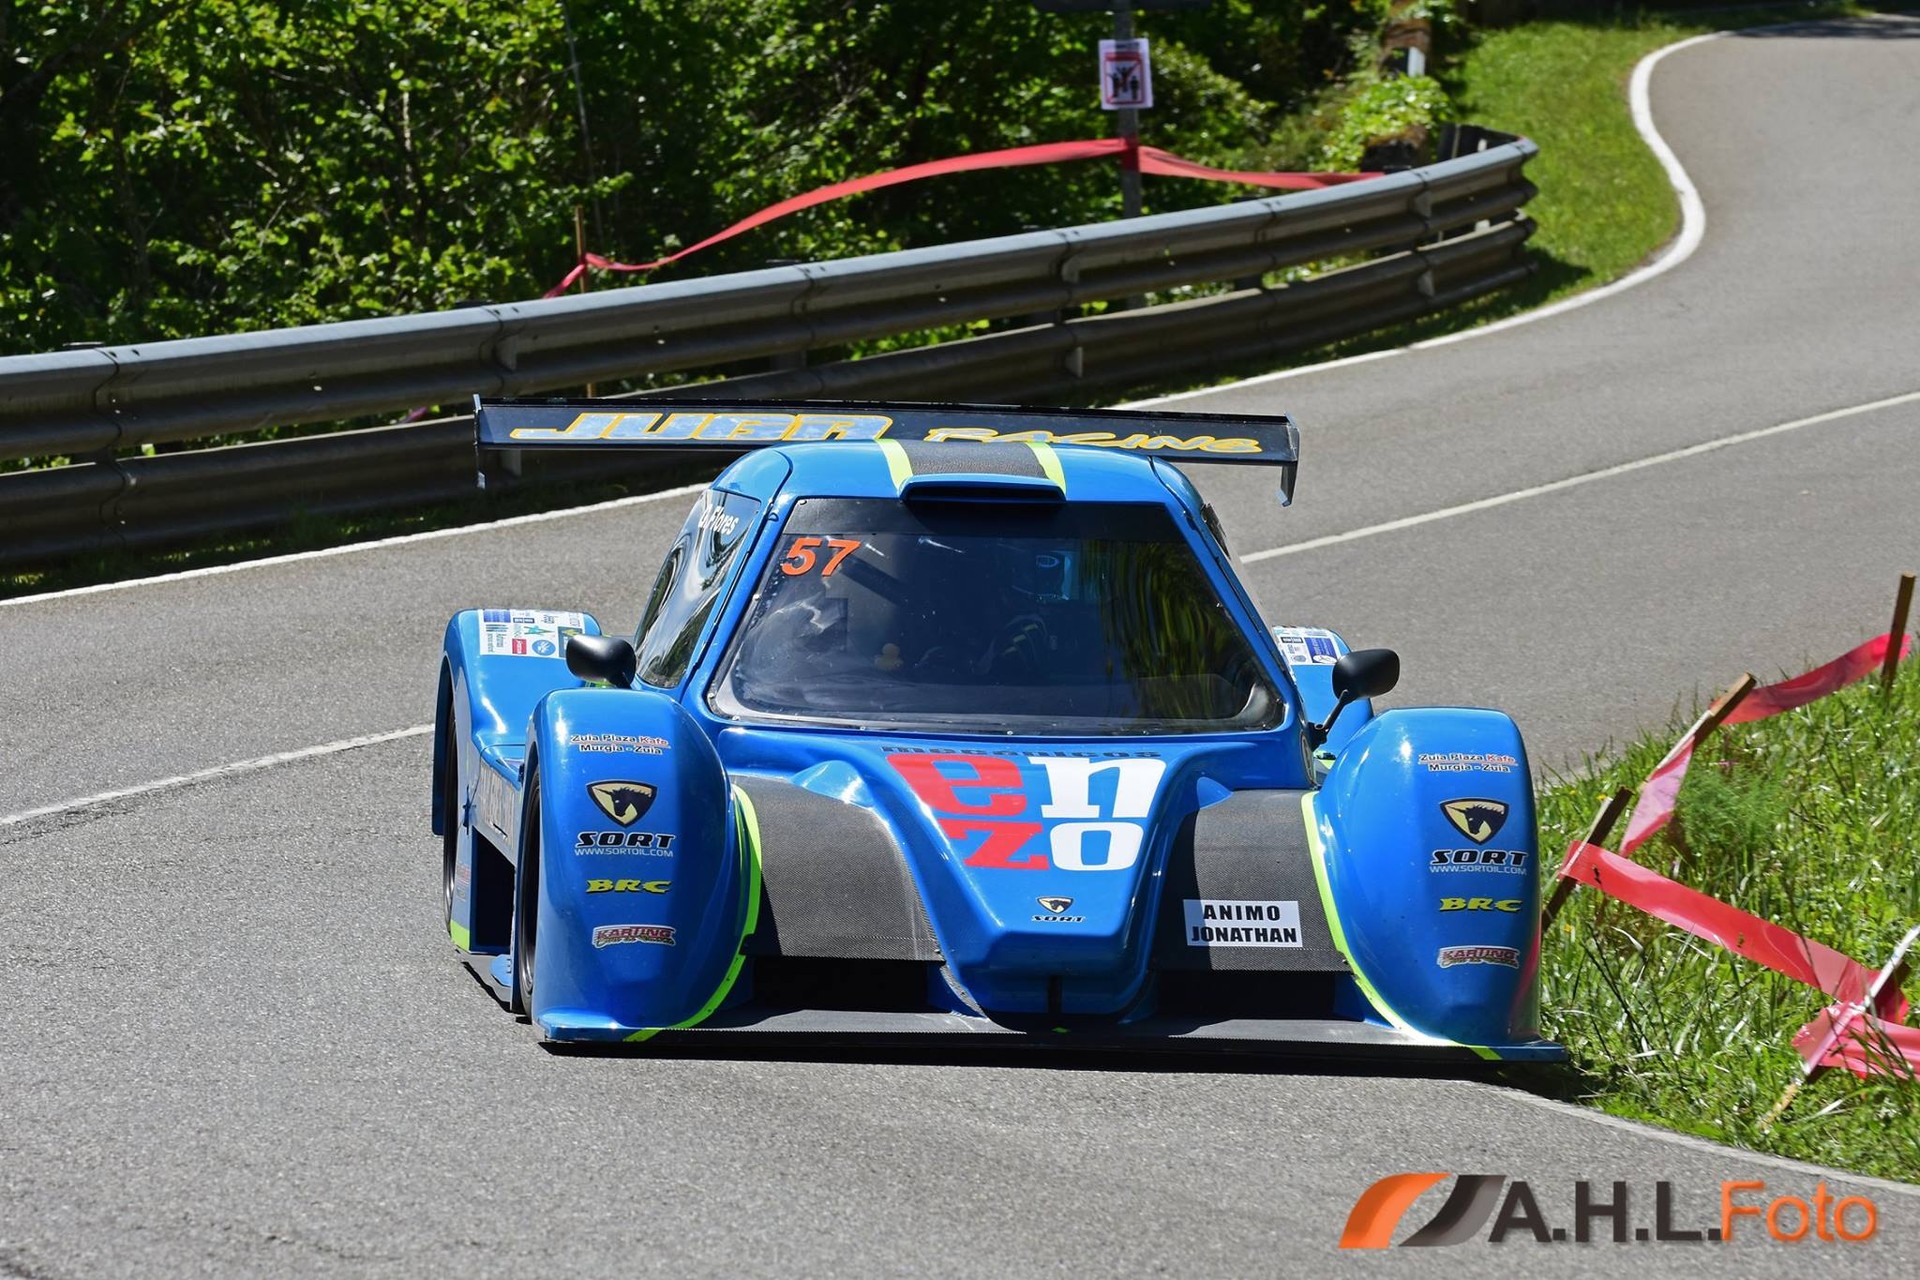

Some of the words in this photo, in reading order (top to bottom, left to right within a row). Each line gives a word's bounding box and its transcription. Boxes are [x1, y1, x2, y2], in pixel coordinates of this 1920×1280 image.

[781, 537, 861, 577] 57
[602, 734, 637, 744] Plaza
[580, 744, 624, 754] Murgia
[633, 745, 662, 755] Zuia
[1449, 752, 1484, 762] Plaza
[1428, 762, 1472, 773] Murgia
[1481, 763, 1511, 773] Zuia
[576, 831, 676, 848] SORT
[574, 847, 674, 857] WWW.SORTOIL.COM
[1430, 849, 1529, 866] SORT
[1429, 865, 1528, 876] WWW.SORTOIL.COM
[586, 879, 673, 895] BRC
[1439, 897, 1523, 913] BRC
[1031, 914, 1086, 923] SORT
[1203, 904, 1281, 921] ANIMO
[597, 927, 673, 939] KARTING
[1191, 926, 1297, 943] JONATHAN
[1442, 948, 1516, 960] KARTING
